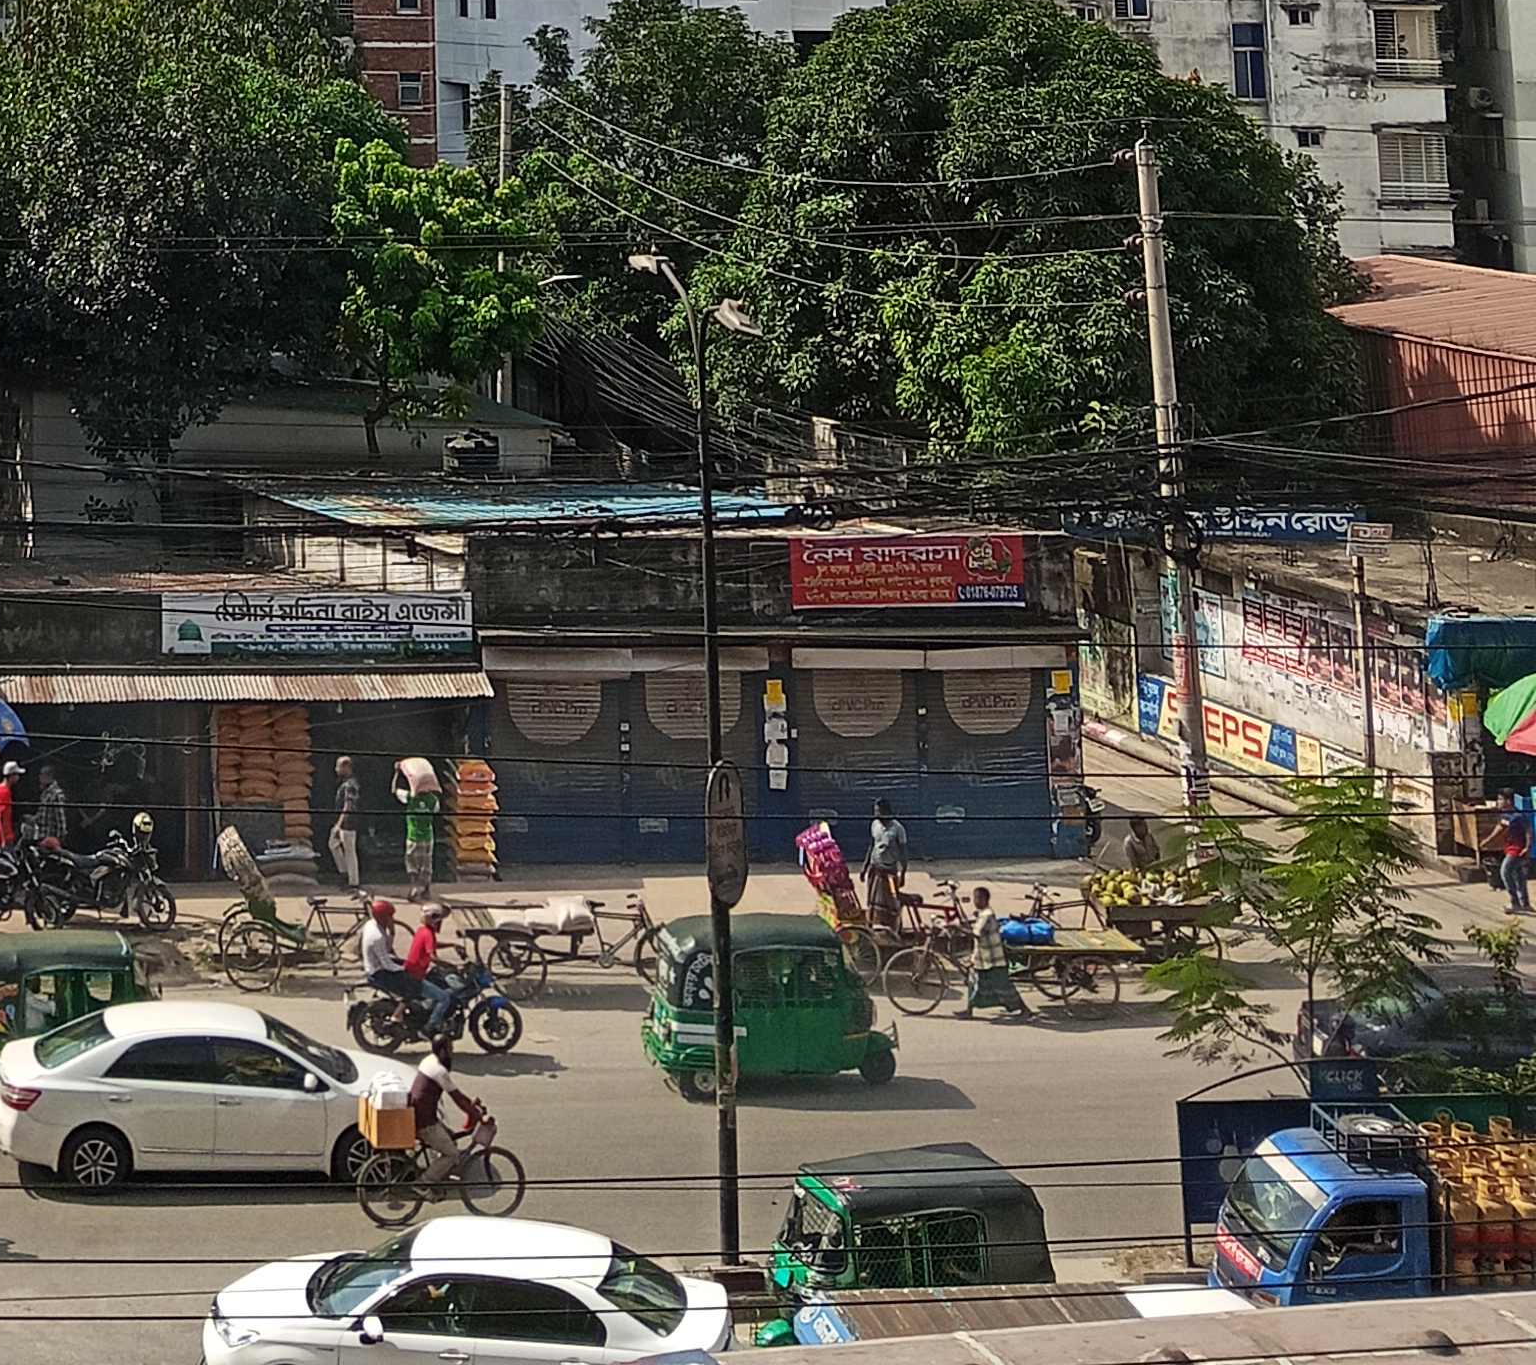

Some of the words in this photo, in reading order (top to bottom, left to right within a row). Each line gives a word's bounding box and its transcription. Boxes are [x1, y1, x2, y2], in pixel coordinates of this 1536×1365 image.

[1290, 510, 1355, 534] রোড
[801, 538, 855, 564] নৈশ
[859, 544, 963, 564] মাদরাসা
[1167, 692, 1263, 762] SEPS
